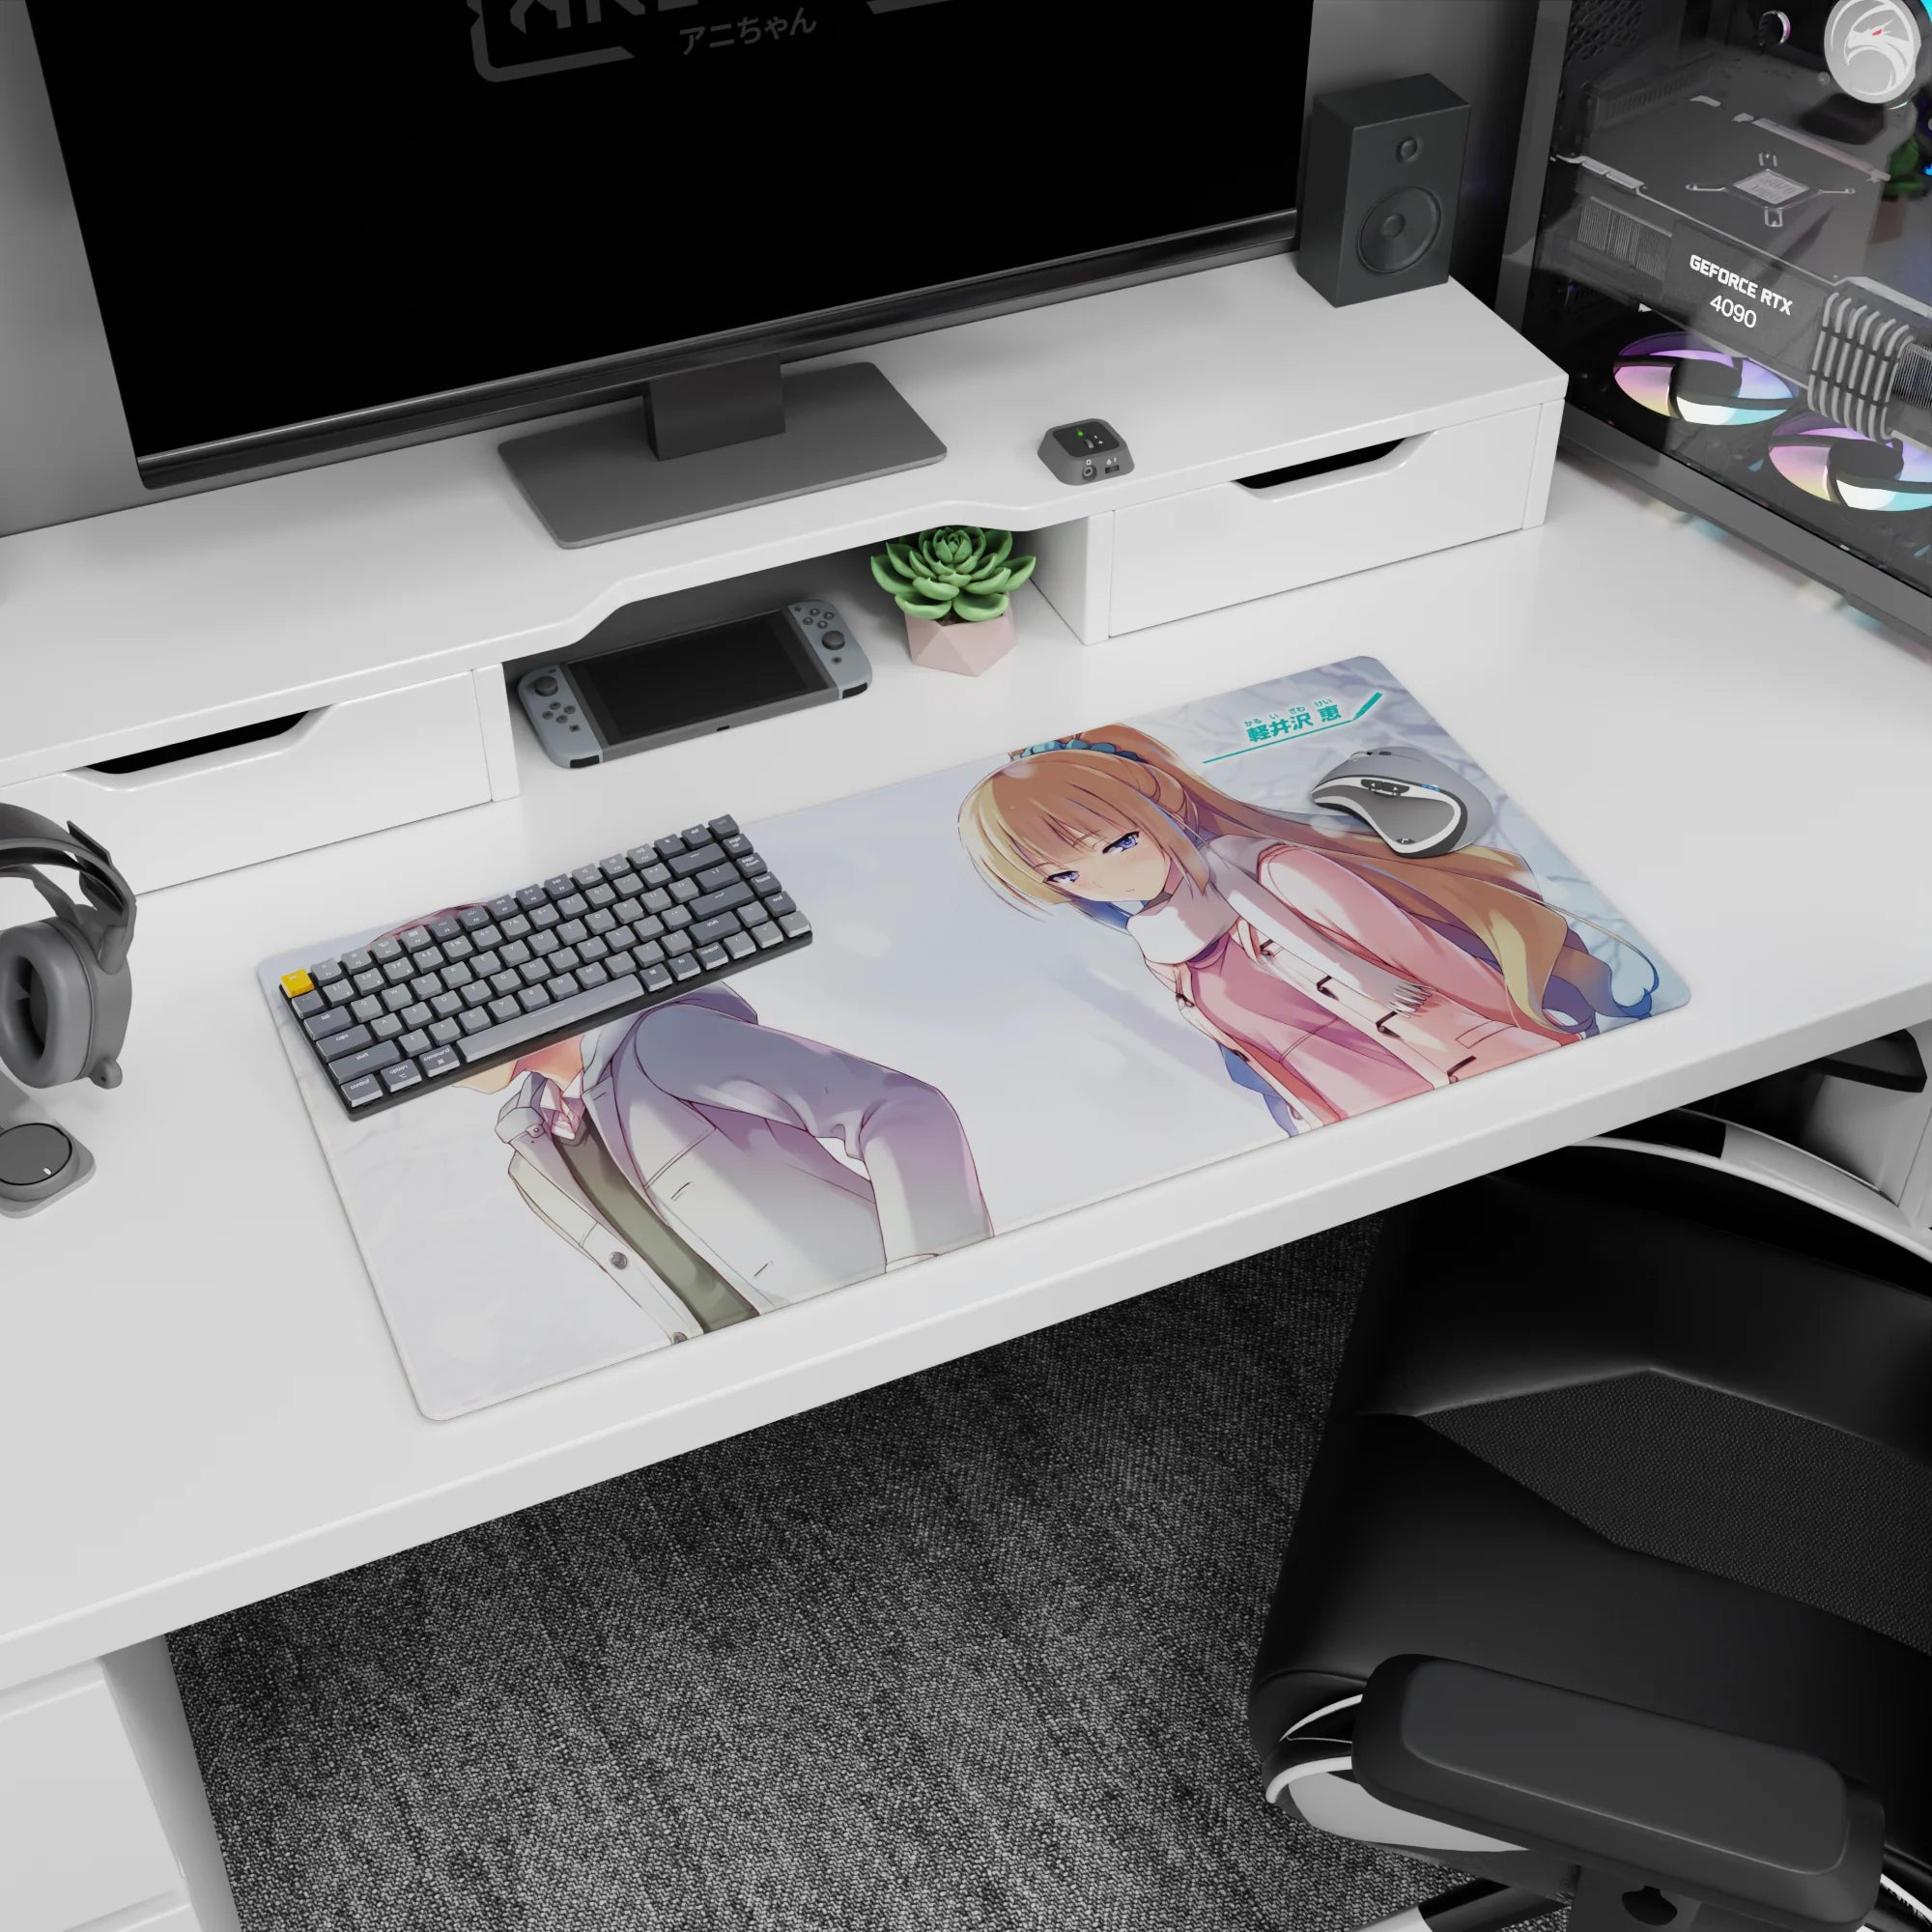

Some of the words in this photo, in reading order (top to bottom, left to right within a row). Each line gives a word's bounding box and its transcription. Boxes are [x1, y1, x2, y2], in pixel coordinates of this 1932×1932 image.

[679, 7, 817, 56] アニちゃん
[1690, 254, 1758, 299] GEFORCE
[1760, 288, 1793, 316] RTX
[1709, 295, 1757, 328] 4090
[423, 1047, 450, 1062] command
